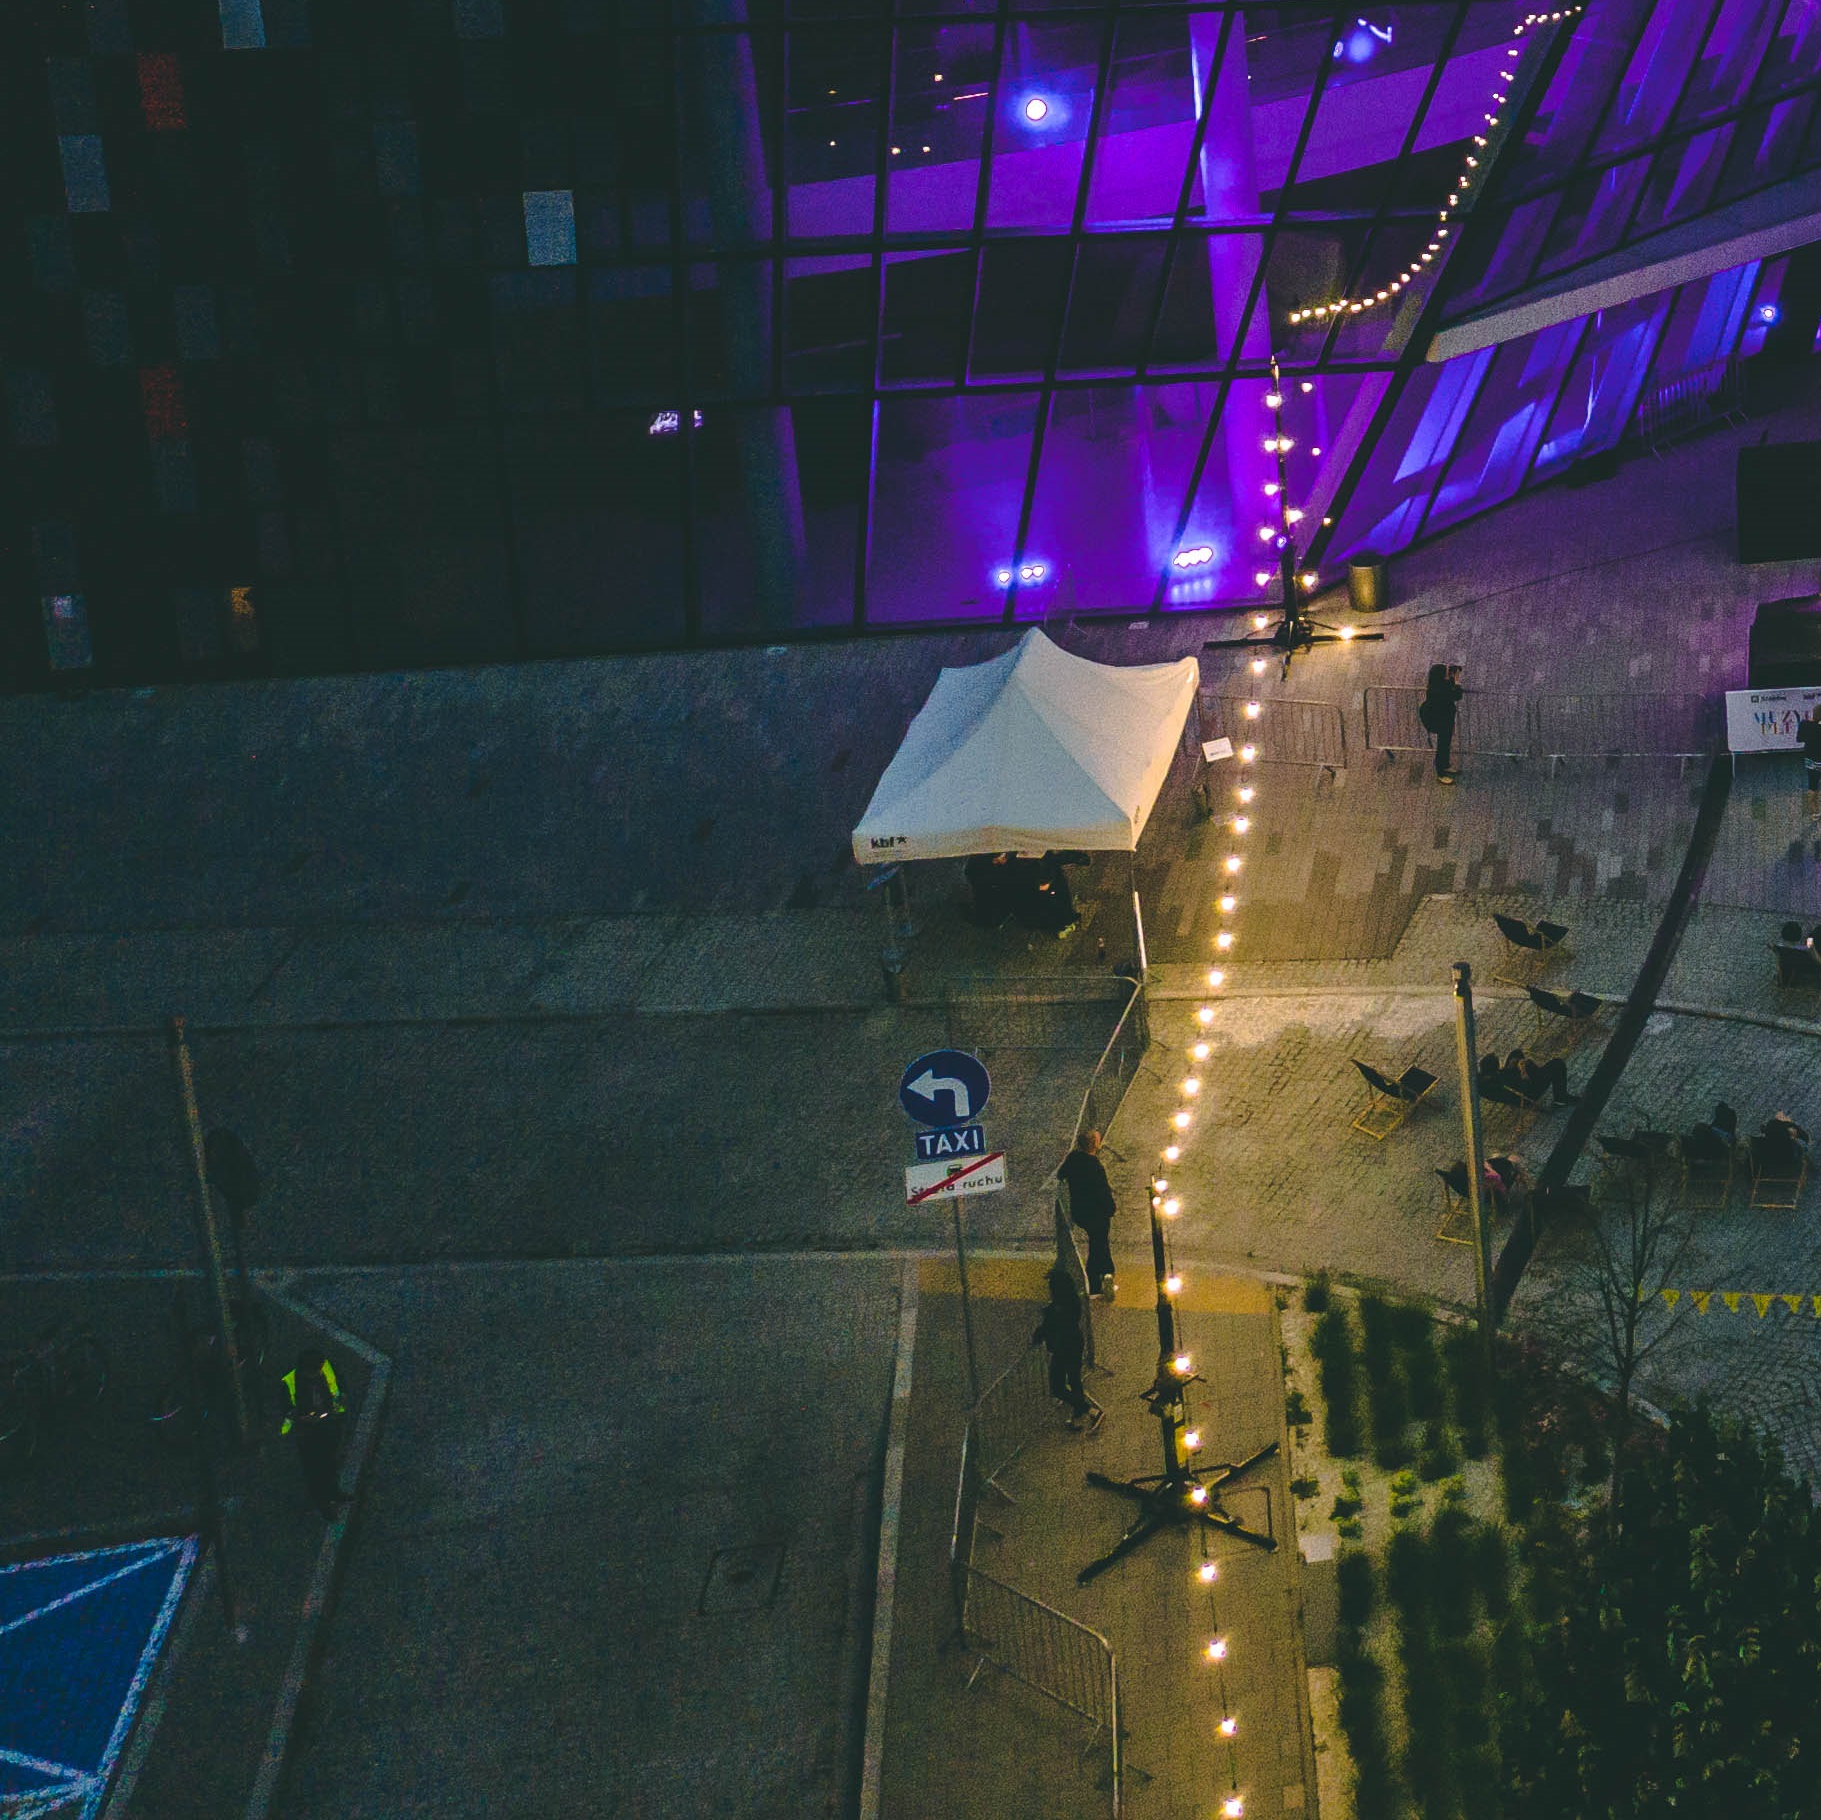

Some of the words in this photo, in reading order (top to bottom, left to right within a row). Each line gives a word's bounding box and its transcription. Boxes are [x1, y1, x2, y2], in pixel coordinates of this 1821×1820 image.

[870, 836, 895, 849] kbf
[919, 1129, 979, 1157] TAXI
[911, 1183, 956, 1198] Sta
[963, 1174, 1003, 1189] ruchu
